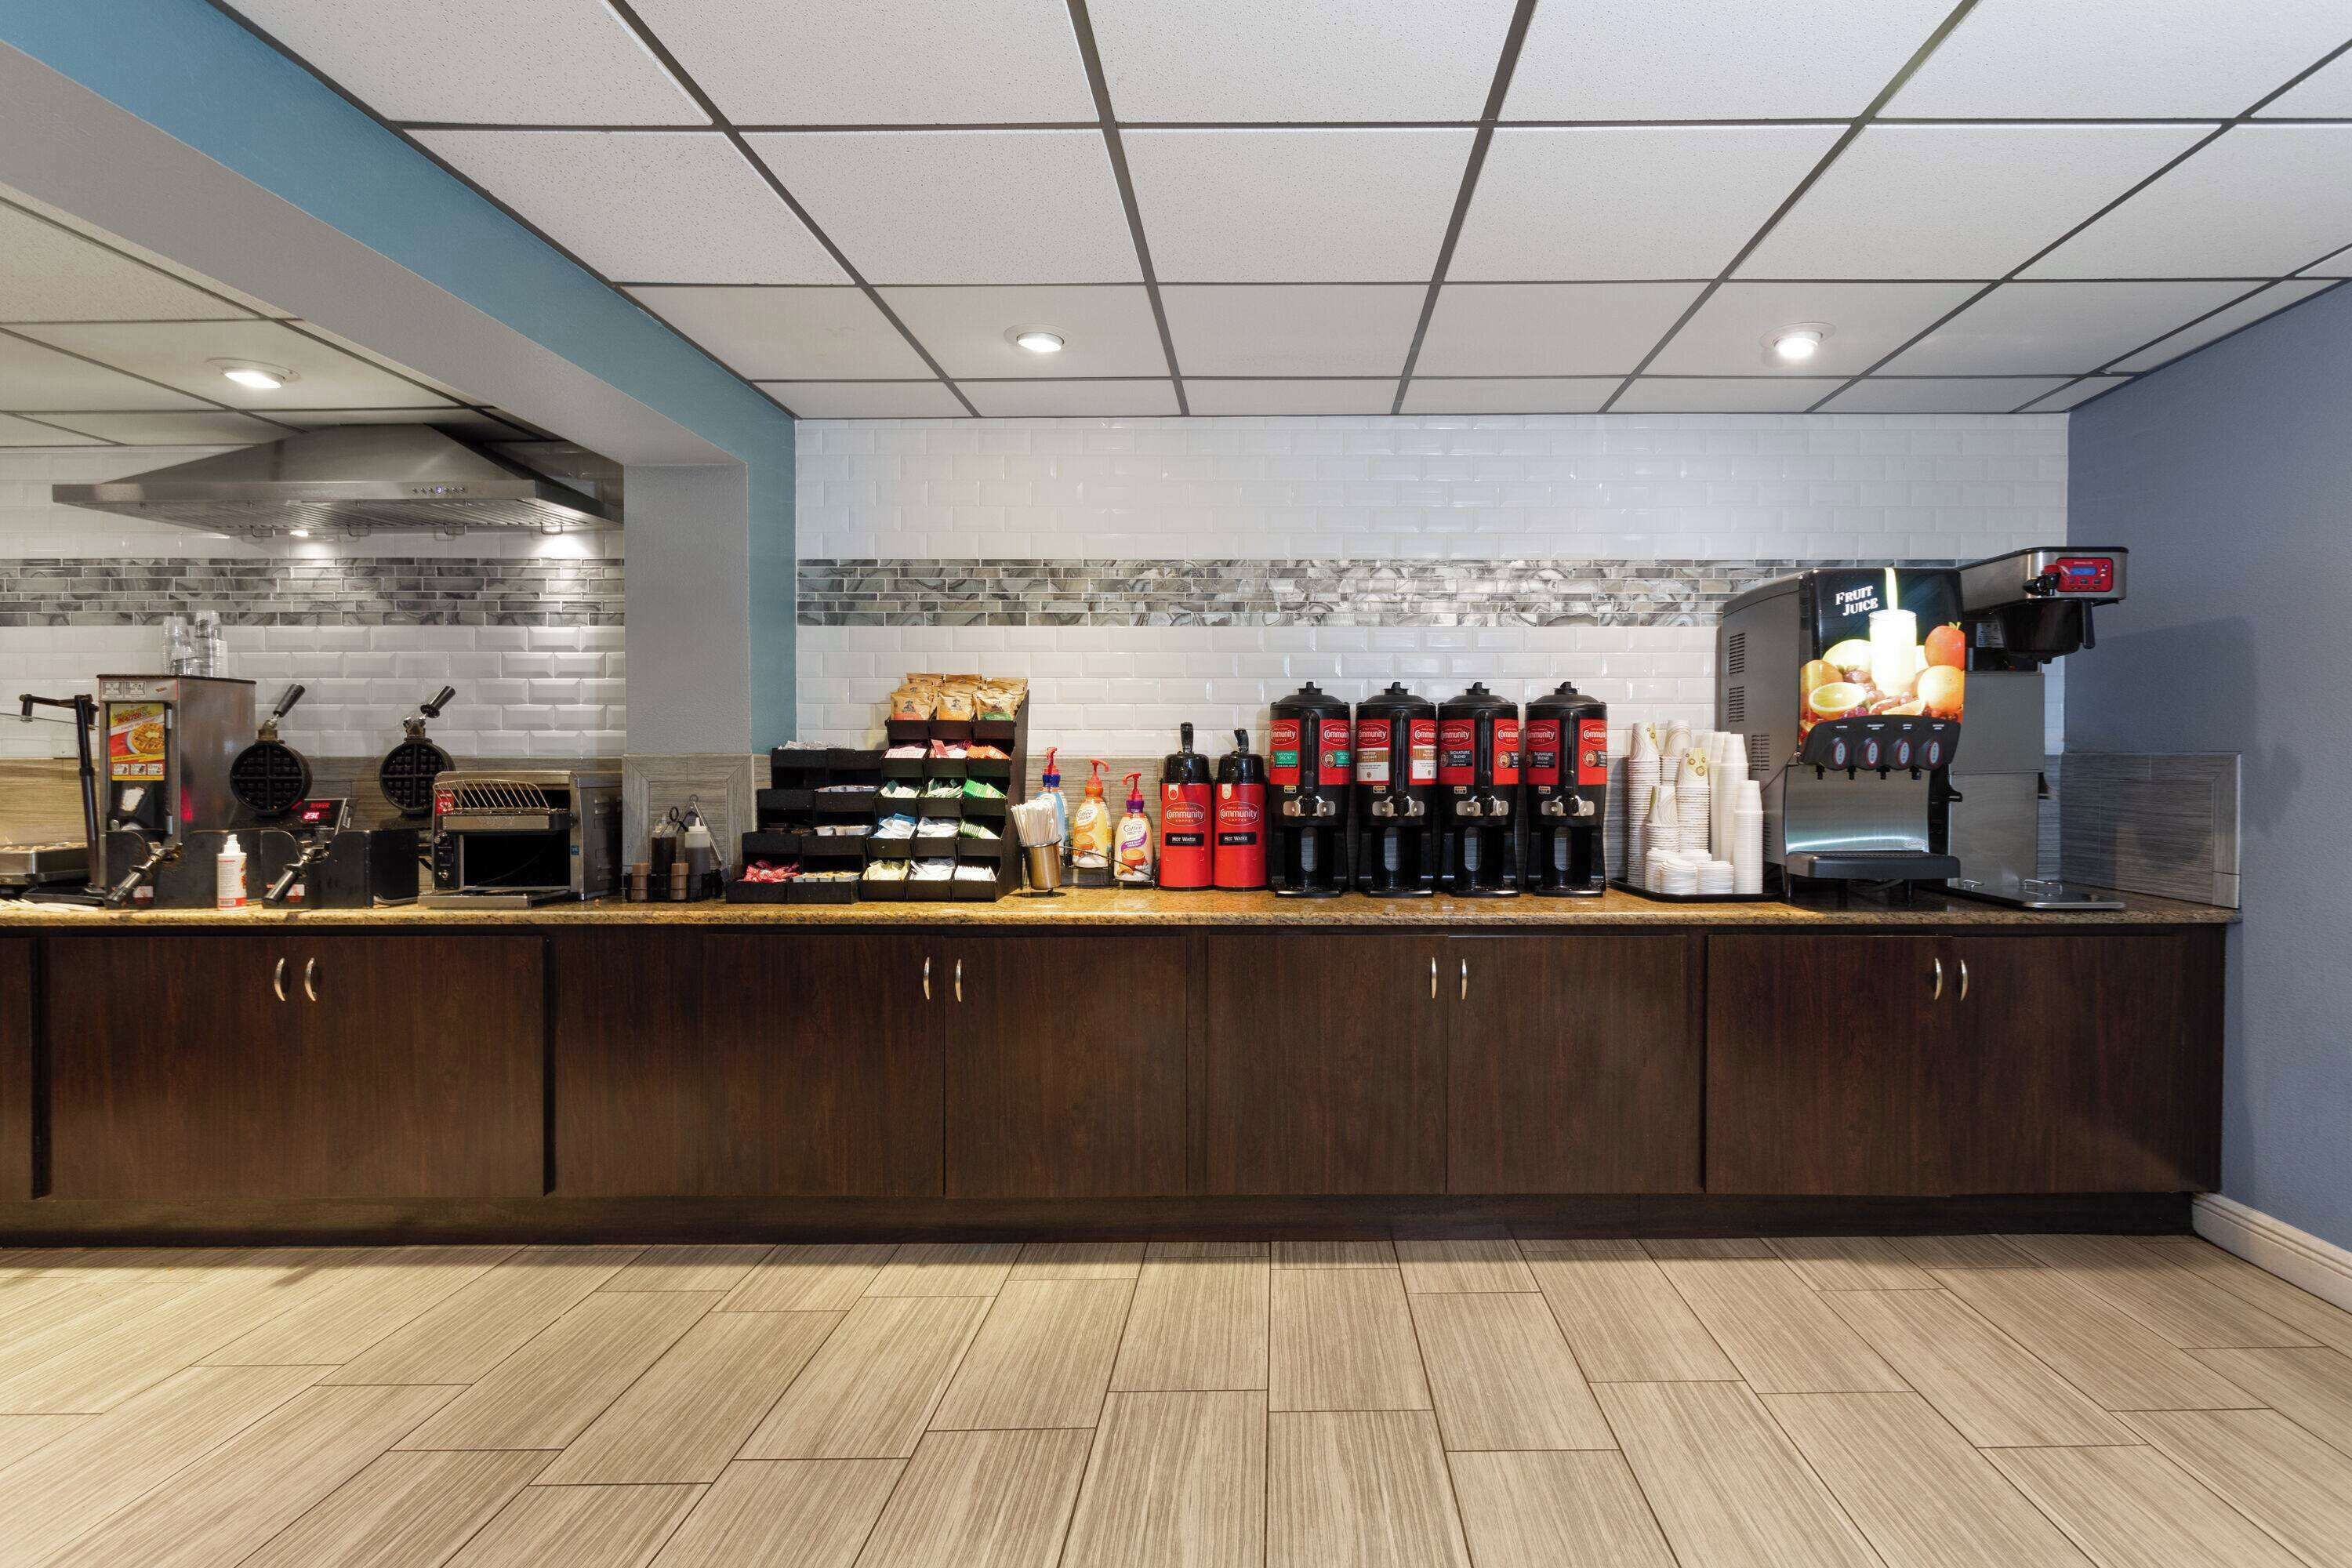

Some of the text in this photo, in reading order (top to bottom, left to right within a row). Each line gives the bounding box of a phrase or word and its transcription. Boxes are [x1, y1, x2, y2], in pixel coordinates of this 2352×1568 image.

[1835, 585, 1873, 605] FRUIT
[1842, 597, 1878, 616] JUICE
[1167, 810, 1203, 820] Community
[1220, 808, 1257, 818] Community
